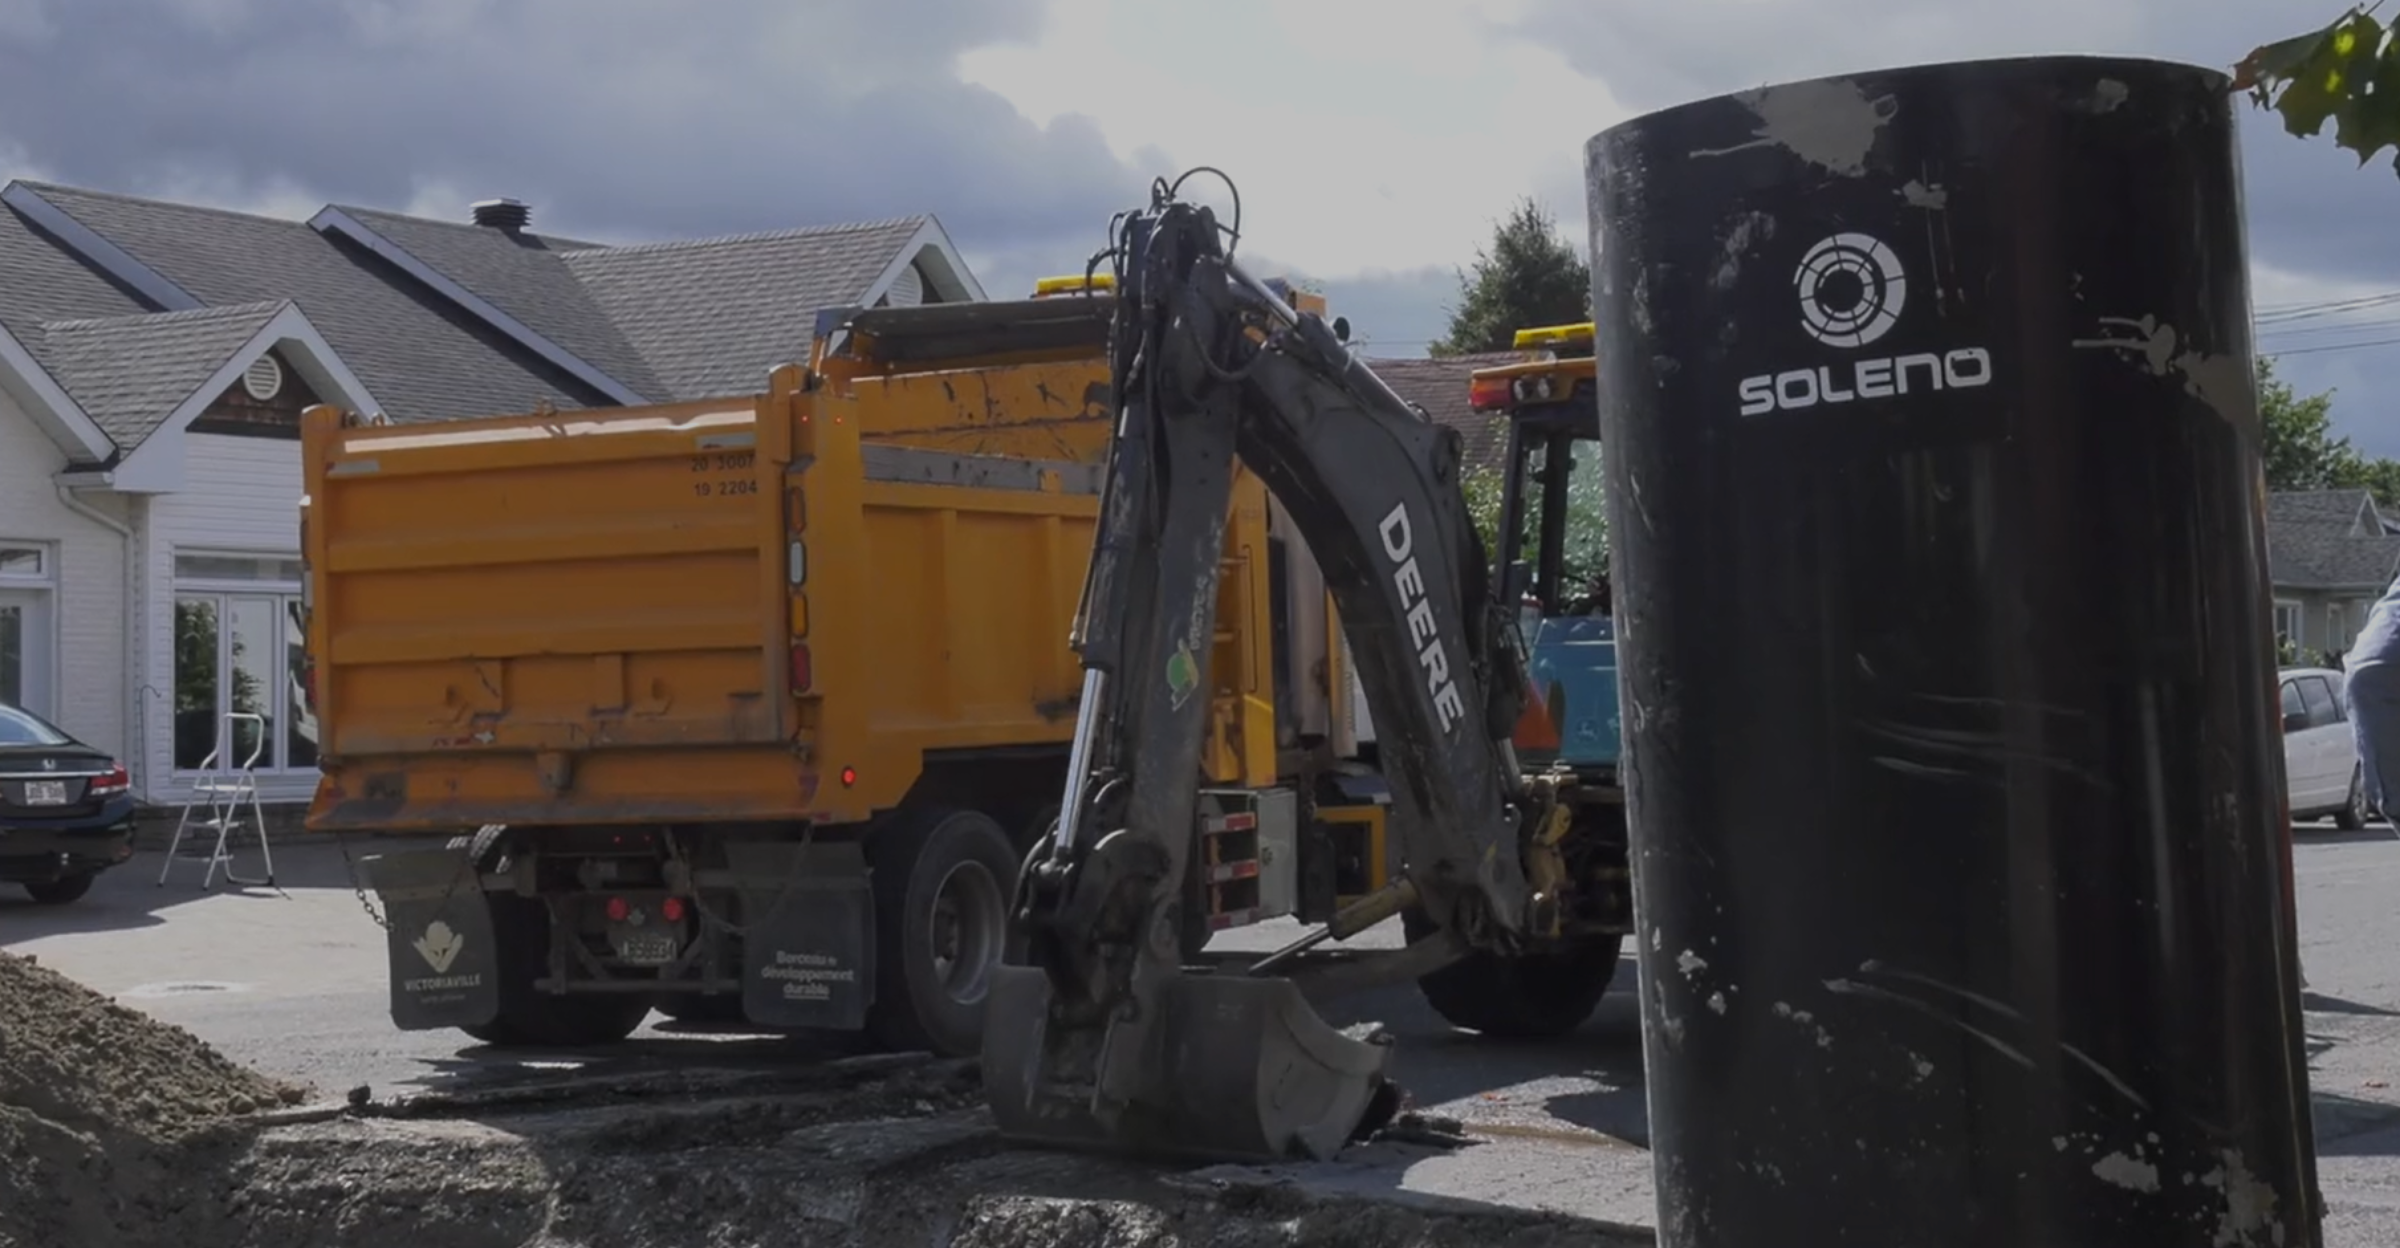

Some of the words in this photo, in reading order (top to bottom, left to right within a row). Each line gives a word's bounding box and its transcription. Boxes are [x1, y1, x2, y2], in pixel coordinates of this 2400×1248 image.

[1739, 347, 1991, 416] SOLENO
[694, 481, 711, 496] 19
[718, 478, 758, 496] 2204
[1379, 502, 1465, 733] DEERE
[404, 973, 481, 992] VICTORIAVILLE
